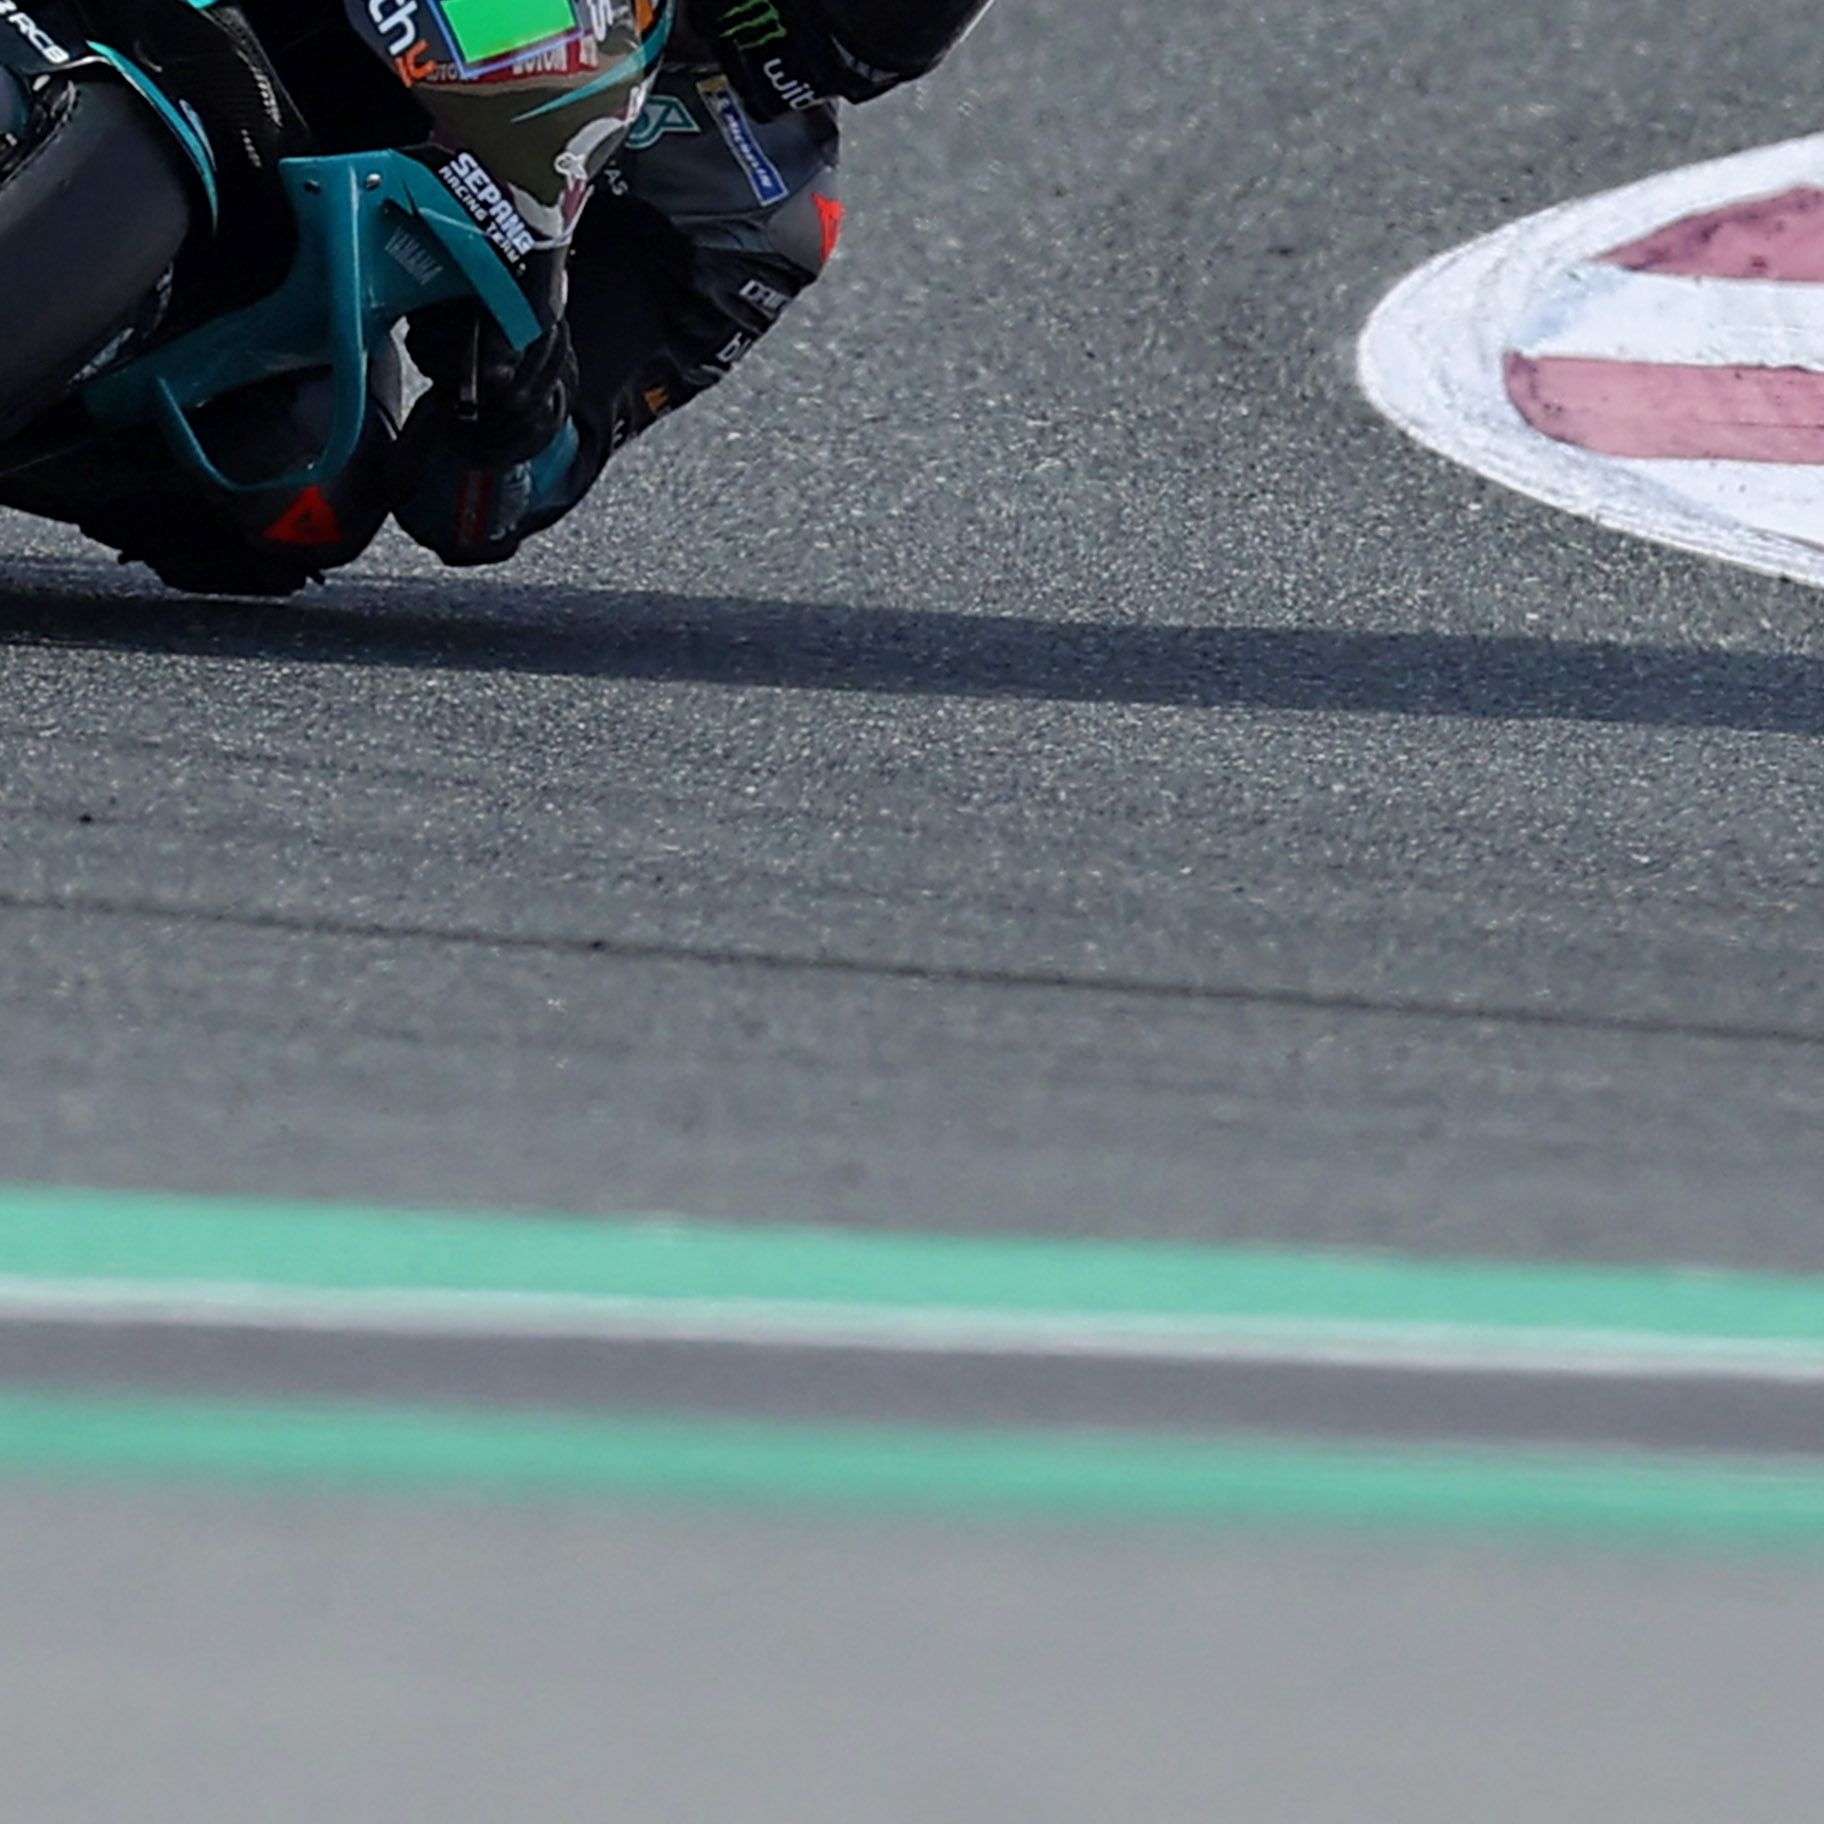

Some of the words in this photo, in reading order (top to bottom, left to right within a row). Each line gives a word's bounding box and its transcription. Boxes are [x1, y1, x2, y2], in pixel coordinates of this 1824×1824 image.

[438, 166, 488, 222] RACING
[486, 222, 520, 264] TEAM
[450, 151, 535, 255] SEPANG
